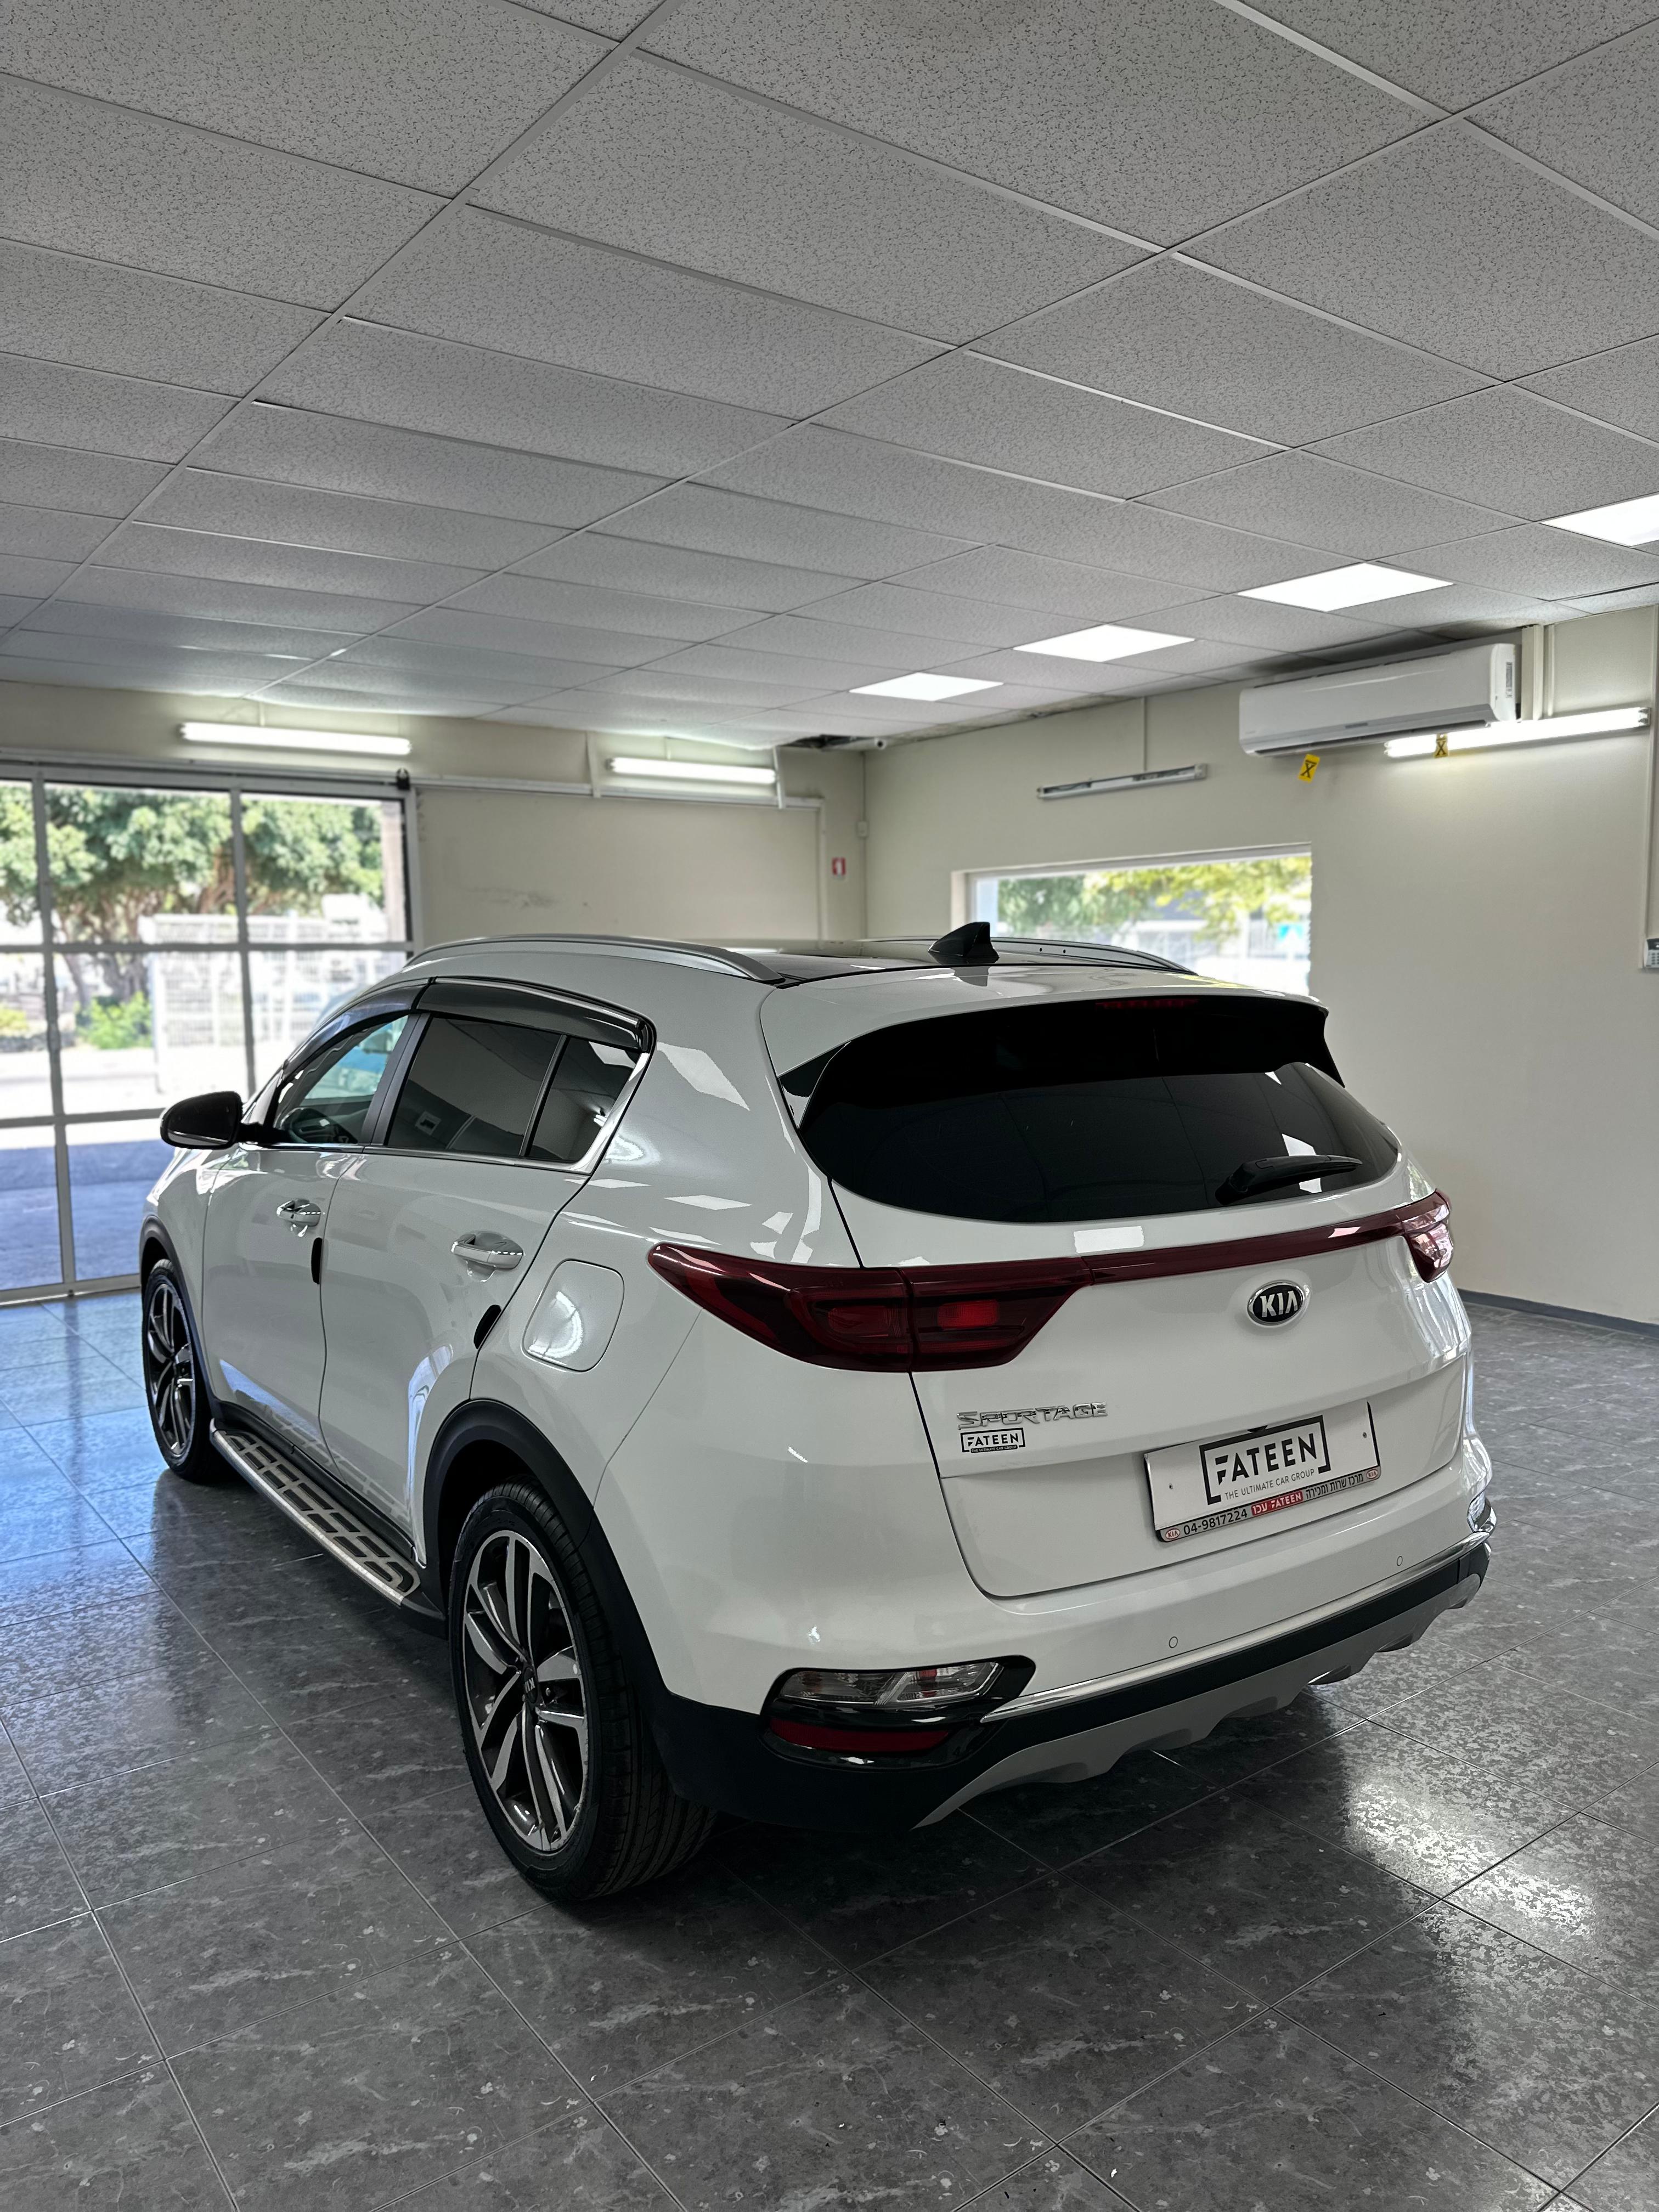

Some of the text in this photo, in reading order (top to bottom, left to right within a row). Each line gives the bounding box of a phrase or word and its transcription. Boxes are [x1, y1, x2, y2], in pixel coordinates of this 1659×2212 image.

[1260, 1290, 1299, 1318] KIA
[957, 1402, 1108, 1430] SPORTAGE
[967, 1433, 1019, 1447] FATEEN
[1214, 1433, 1317, 1485] FATEEN
[1224, 1468, 1315, 1500] THE ULTIMATE CAR GROUP
[1252, 1473, 1364, 1514] מרכז שרות ומכירה FATEEN עכו
[1183, 1509, 1248, 1535] 04-9817224
